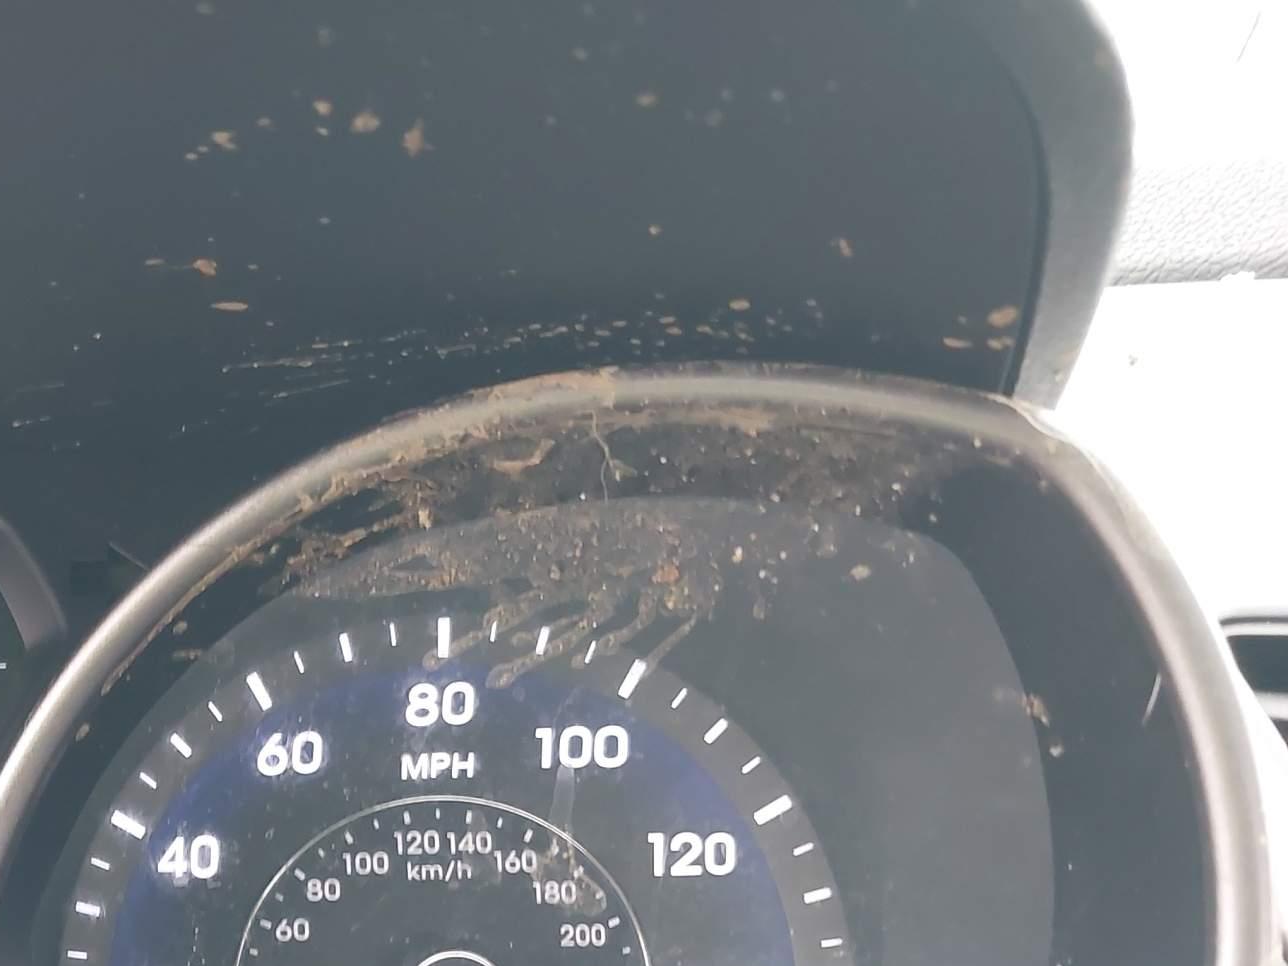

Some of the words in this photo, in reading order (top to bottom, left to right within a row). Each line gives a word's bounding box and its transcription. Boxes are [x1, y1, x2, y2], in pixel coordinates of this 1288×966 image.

[405, 681, 476, 727] 80
[256, 730, 324, 777] 60
[535, 725, 629, 769] 100
[401, 751, 476, 781] MPH
[393, 829, 440, 856] 120
[446, 830, 493, 855] 140
[647, 831, 737, 877] 120
[157, 833, 221, 879] 40
[342, 851, 390, 875] 100
[493, 849, 538, 874] 160
[406, 859, 472, 882] km/h
[306, 878, 341, 902] 80
[532, 879, 577, 905] 180
[275, 917, 310, 942] 60
[560, 923, 606, 947] 200
